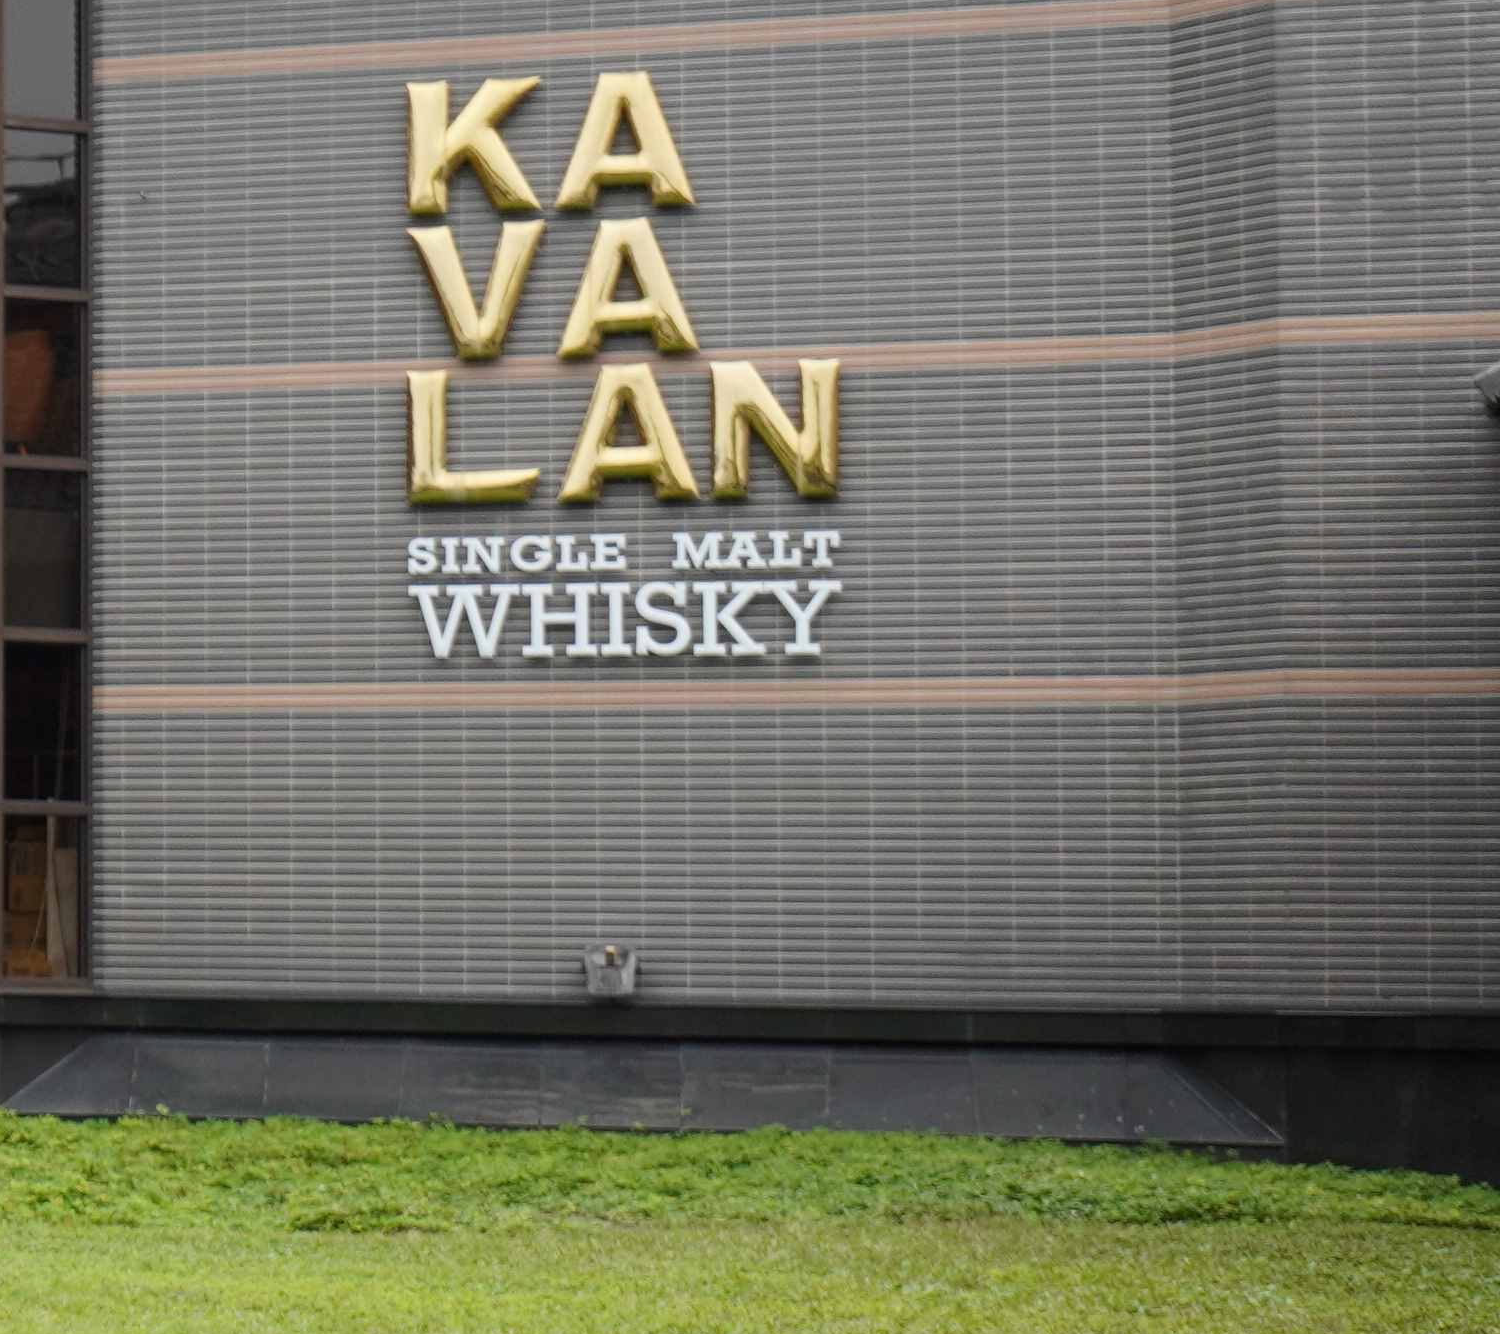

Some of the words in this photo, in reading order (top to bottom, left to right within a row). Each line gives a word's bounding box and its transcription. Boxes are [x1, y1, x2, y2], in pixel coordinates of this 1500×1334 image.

[406, 70, 698, 214] KA
[406, 217, 701, 360] VA
[406, 358, 841, 503] LAN
[407, 533, 628, 575] SINGLE
[672, 530, 841, 569] MALT
[408, 580, 843, 658] WHISKY
